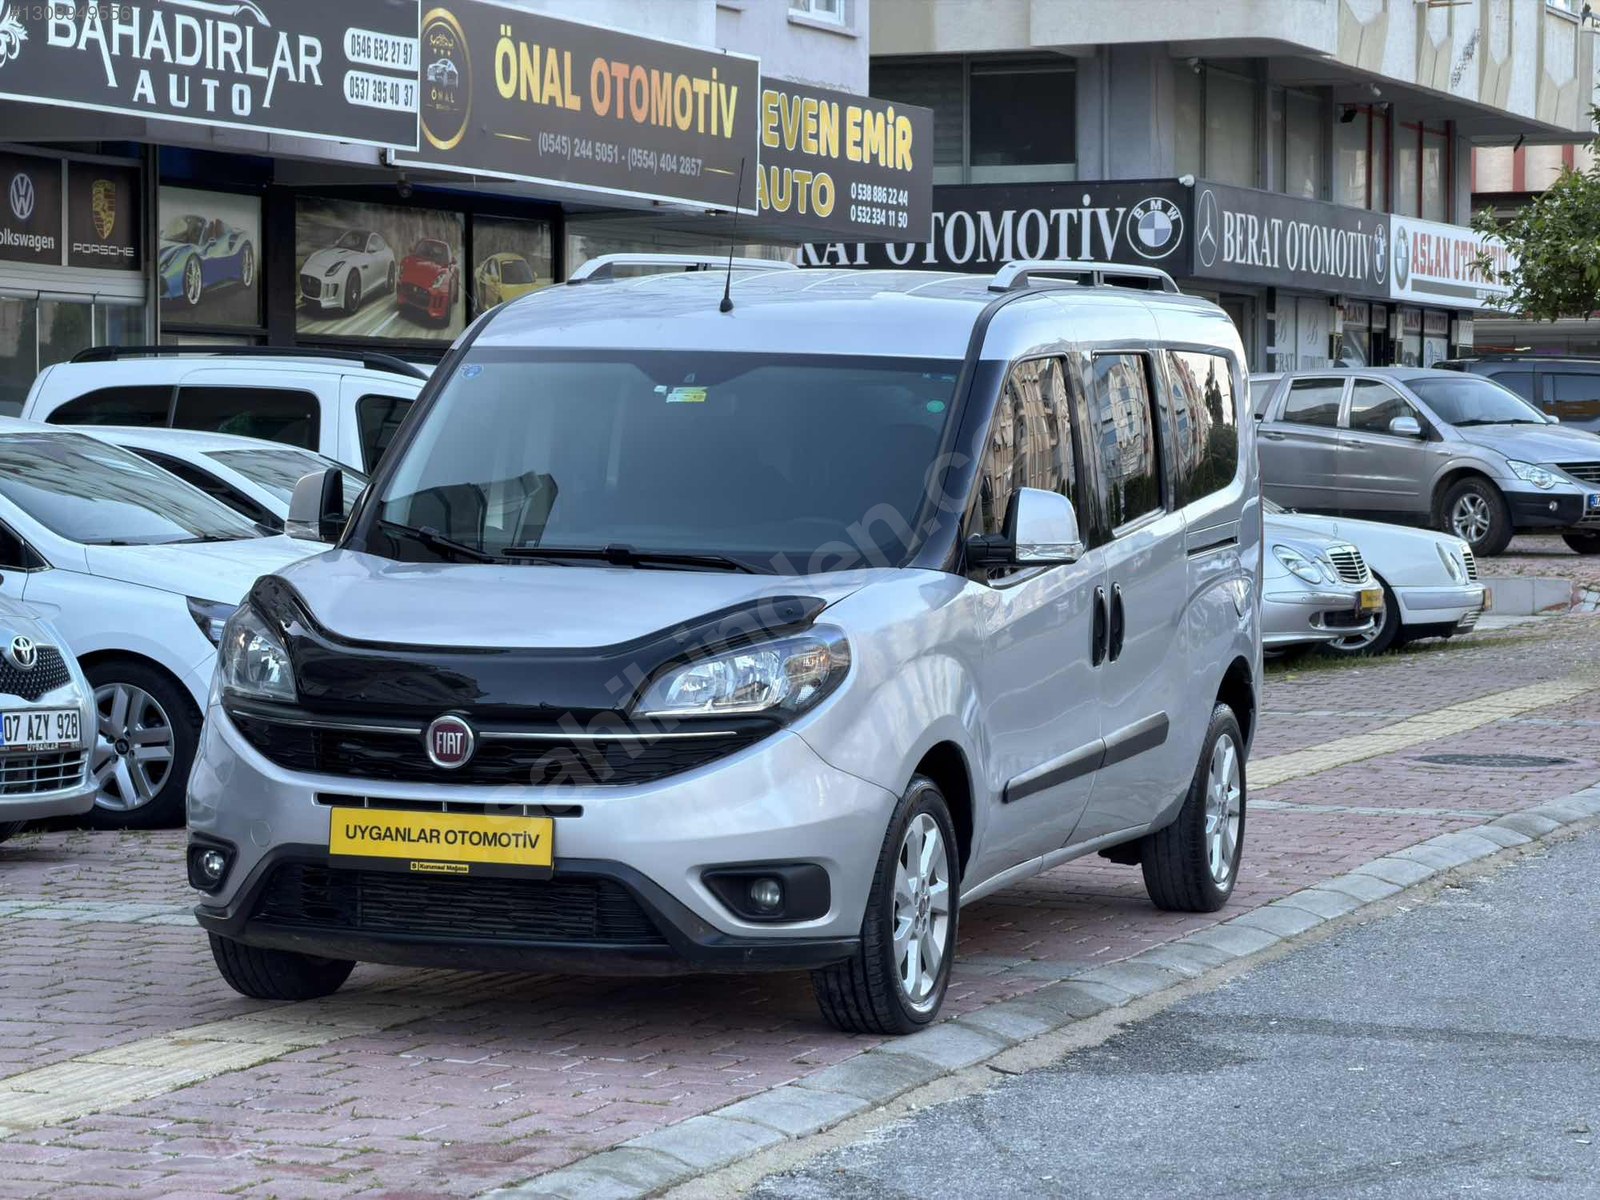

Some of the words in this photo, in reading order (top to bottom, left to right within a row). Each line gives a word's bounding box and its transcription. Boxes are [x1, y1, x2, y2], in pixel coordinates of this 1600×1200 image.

[47, 0, 323, 108] BAHADIRLAR
[351, 33, 371, 59] 0546
[373, 38, 389, 61] 652
[391, 41, 401, 64] 27
[403, 43, 413, 65] 97
[132, 69, 252, 116] AUTO
[349, 75, 370, 101] 0537
[372, 80, 388, 104] 395
[389, 82, 400, 105] 40
[403, 84, 414, 107] 37
[494, 24, 581, 112] ÖNAL
[590, 57, 738, 138] OTOMOTİV
[538, 131, 571, 160] (0545)
[573, 137, 593, 159] 244
[595, 141, 619, 163] 5051
[627, 147, 658, 175] (0554)
[659, 152, 677, 173] 404
[679, 156, 703, 176] 2857
[757, 163, 836, 217] AUTO
[850, 182, 857, 199] 0
[857, 183, 871, 201] 538
[872, 185, 887, 203] 886
[888, 187, 898, 205] 22
[898, 189, 908, 206] 44
[850, 204, 857, 222] 0
[857, 205, 871, 223] 532
[871, 207, 886, 225] 334
[888, 210, 896, 227] 11
[897, 211, 908, 228] 50
[1133, 199, 1180, 221] BMW
[73, 243, 135, 257] PORSCHE
[1222, 210, 1283, 268] BERAT
[1286, 219, 1373, 282] OTOMOTİV
[1411, 231, 1451, 279] ASLAN
[4, 714, 20, 741] 07
[27, 714, 49, 741] AZY
[57, 713, 78, 739] 928
[436, 731, 463, 755] FIAT
[345, 824, 440, 845] UYGANLAR
[444, 831, 540, 849] OTOMOTİV
